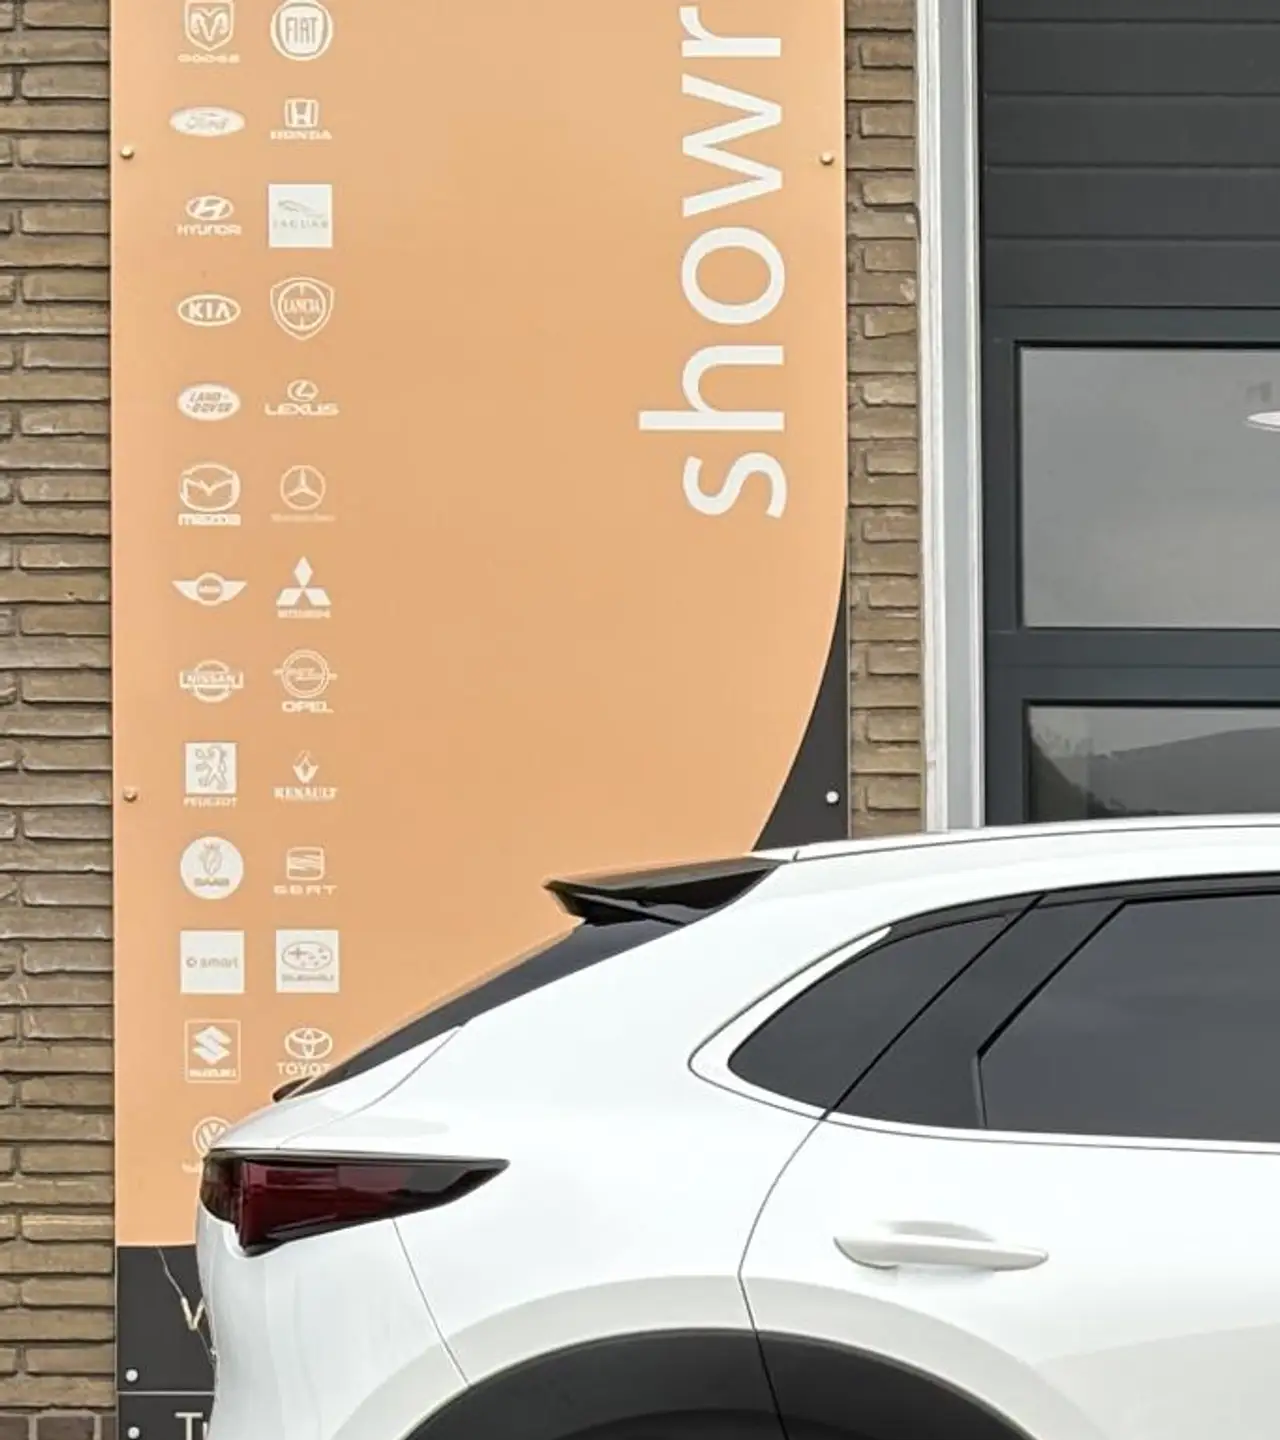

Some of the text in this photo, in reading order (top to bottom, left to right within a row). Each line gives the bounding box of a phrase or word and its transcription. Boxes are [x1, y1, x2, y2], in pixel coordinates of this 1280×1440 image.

[285, 16, 318, 45] FIAT
[269, 130, 333, 141] HONDA
[177, 223, 243, 237] HYUNDAI
[272, 218, 329, 229] JAGUAR
[638, 5, 787, 519] showr
[188, 301, 231, 319] KIA
[264, 402, 340, 416] LEXUS
[281, 700, 335, 714] OPEL
[273, 787, 338, 800] RENAULT
[199, 956, 239, 969] smart
